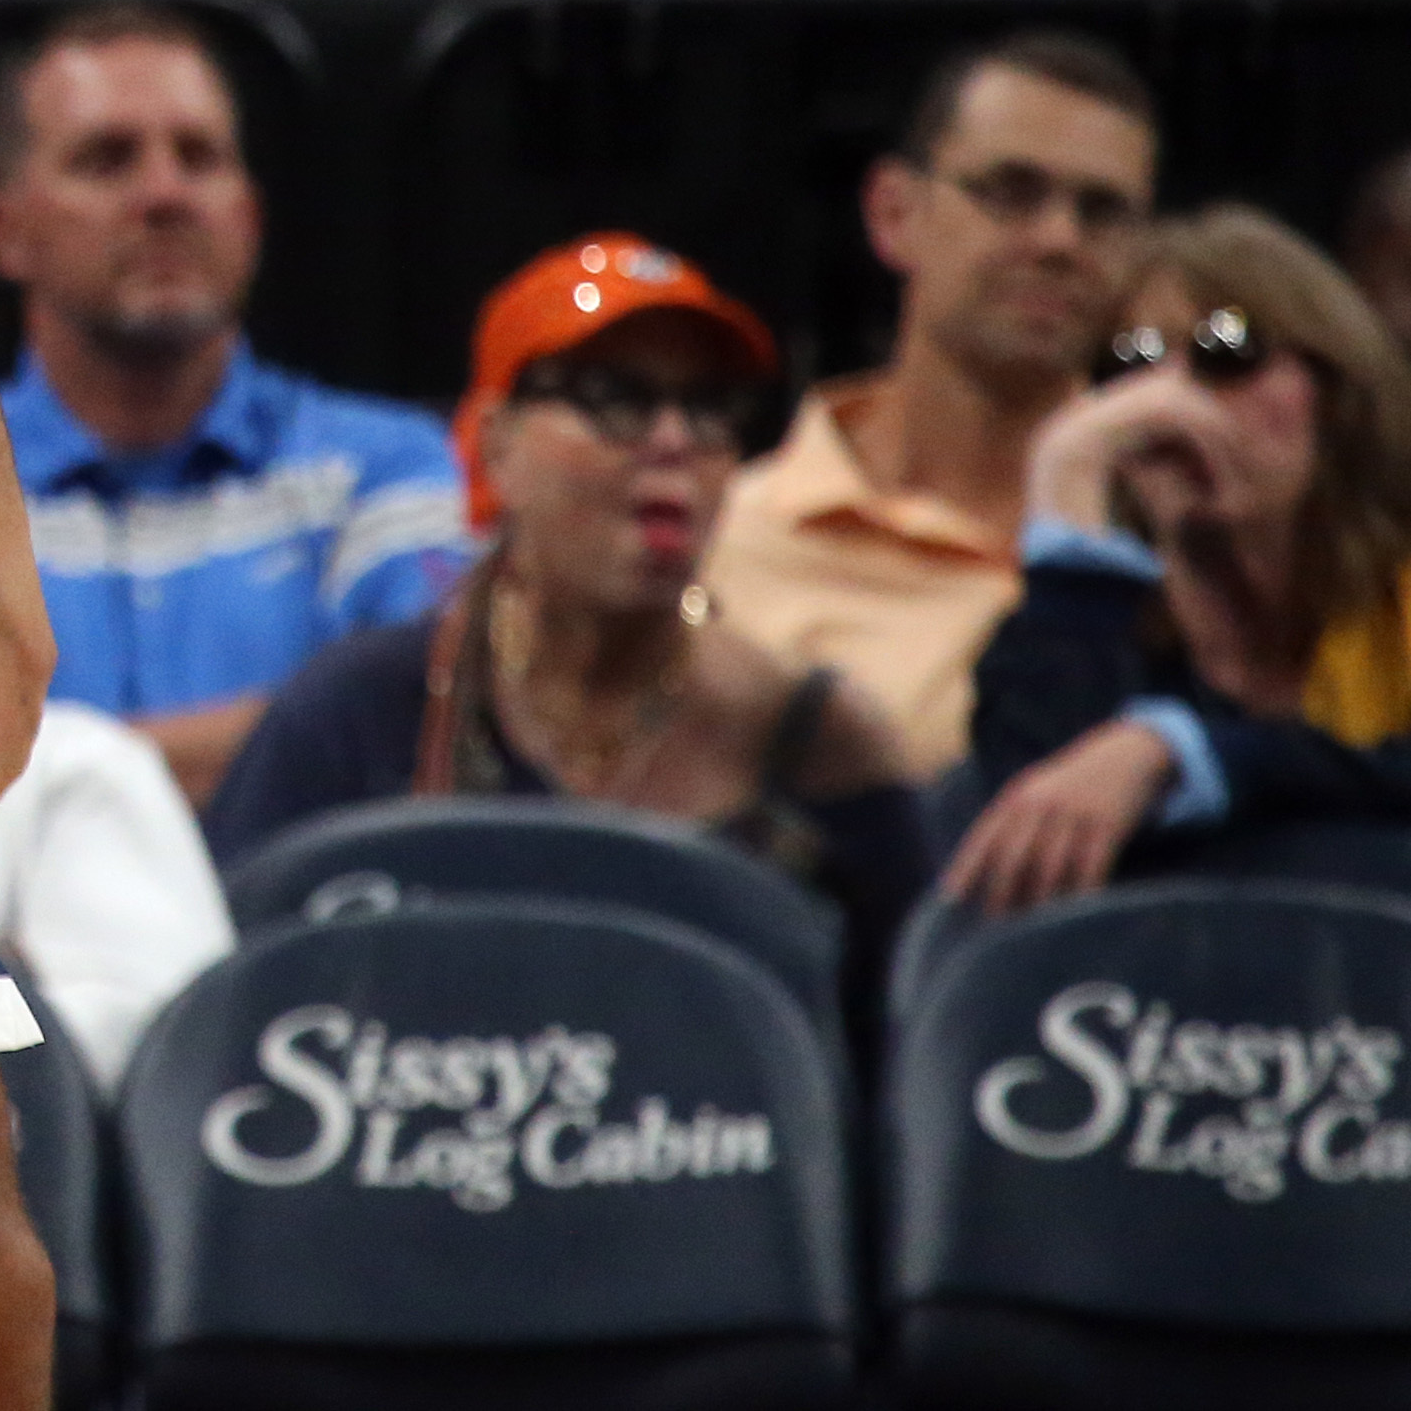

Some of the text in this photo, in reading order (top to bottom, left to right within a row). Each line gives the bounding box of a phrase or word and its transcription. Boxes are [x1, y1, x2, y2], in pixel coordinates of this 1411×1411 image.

[358, 1096, 773, 1213] Log Cabin
[1129, 1092, 1286, 1202] Log
